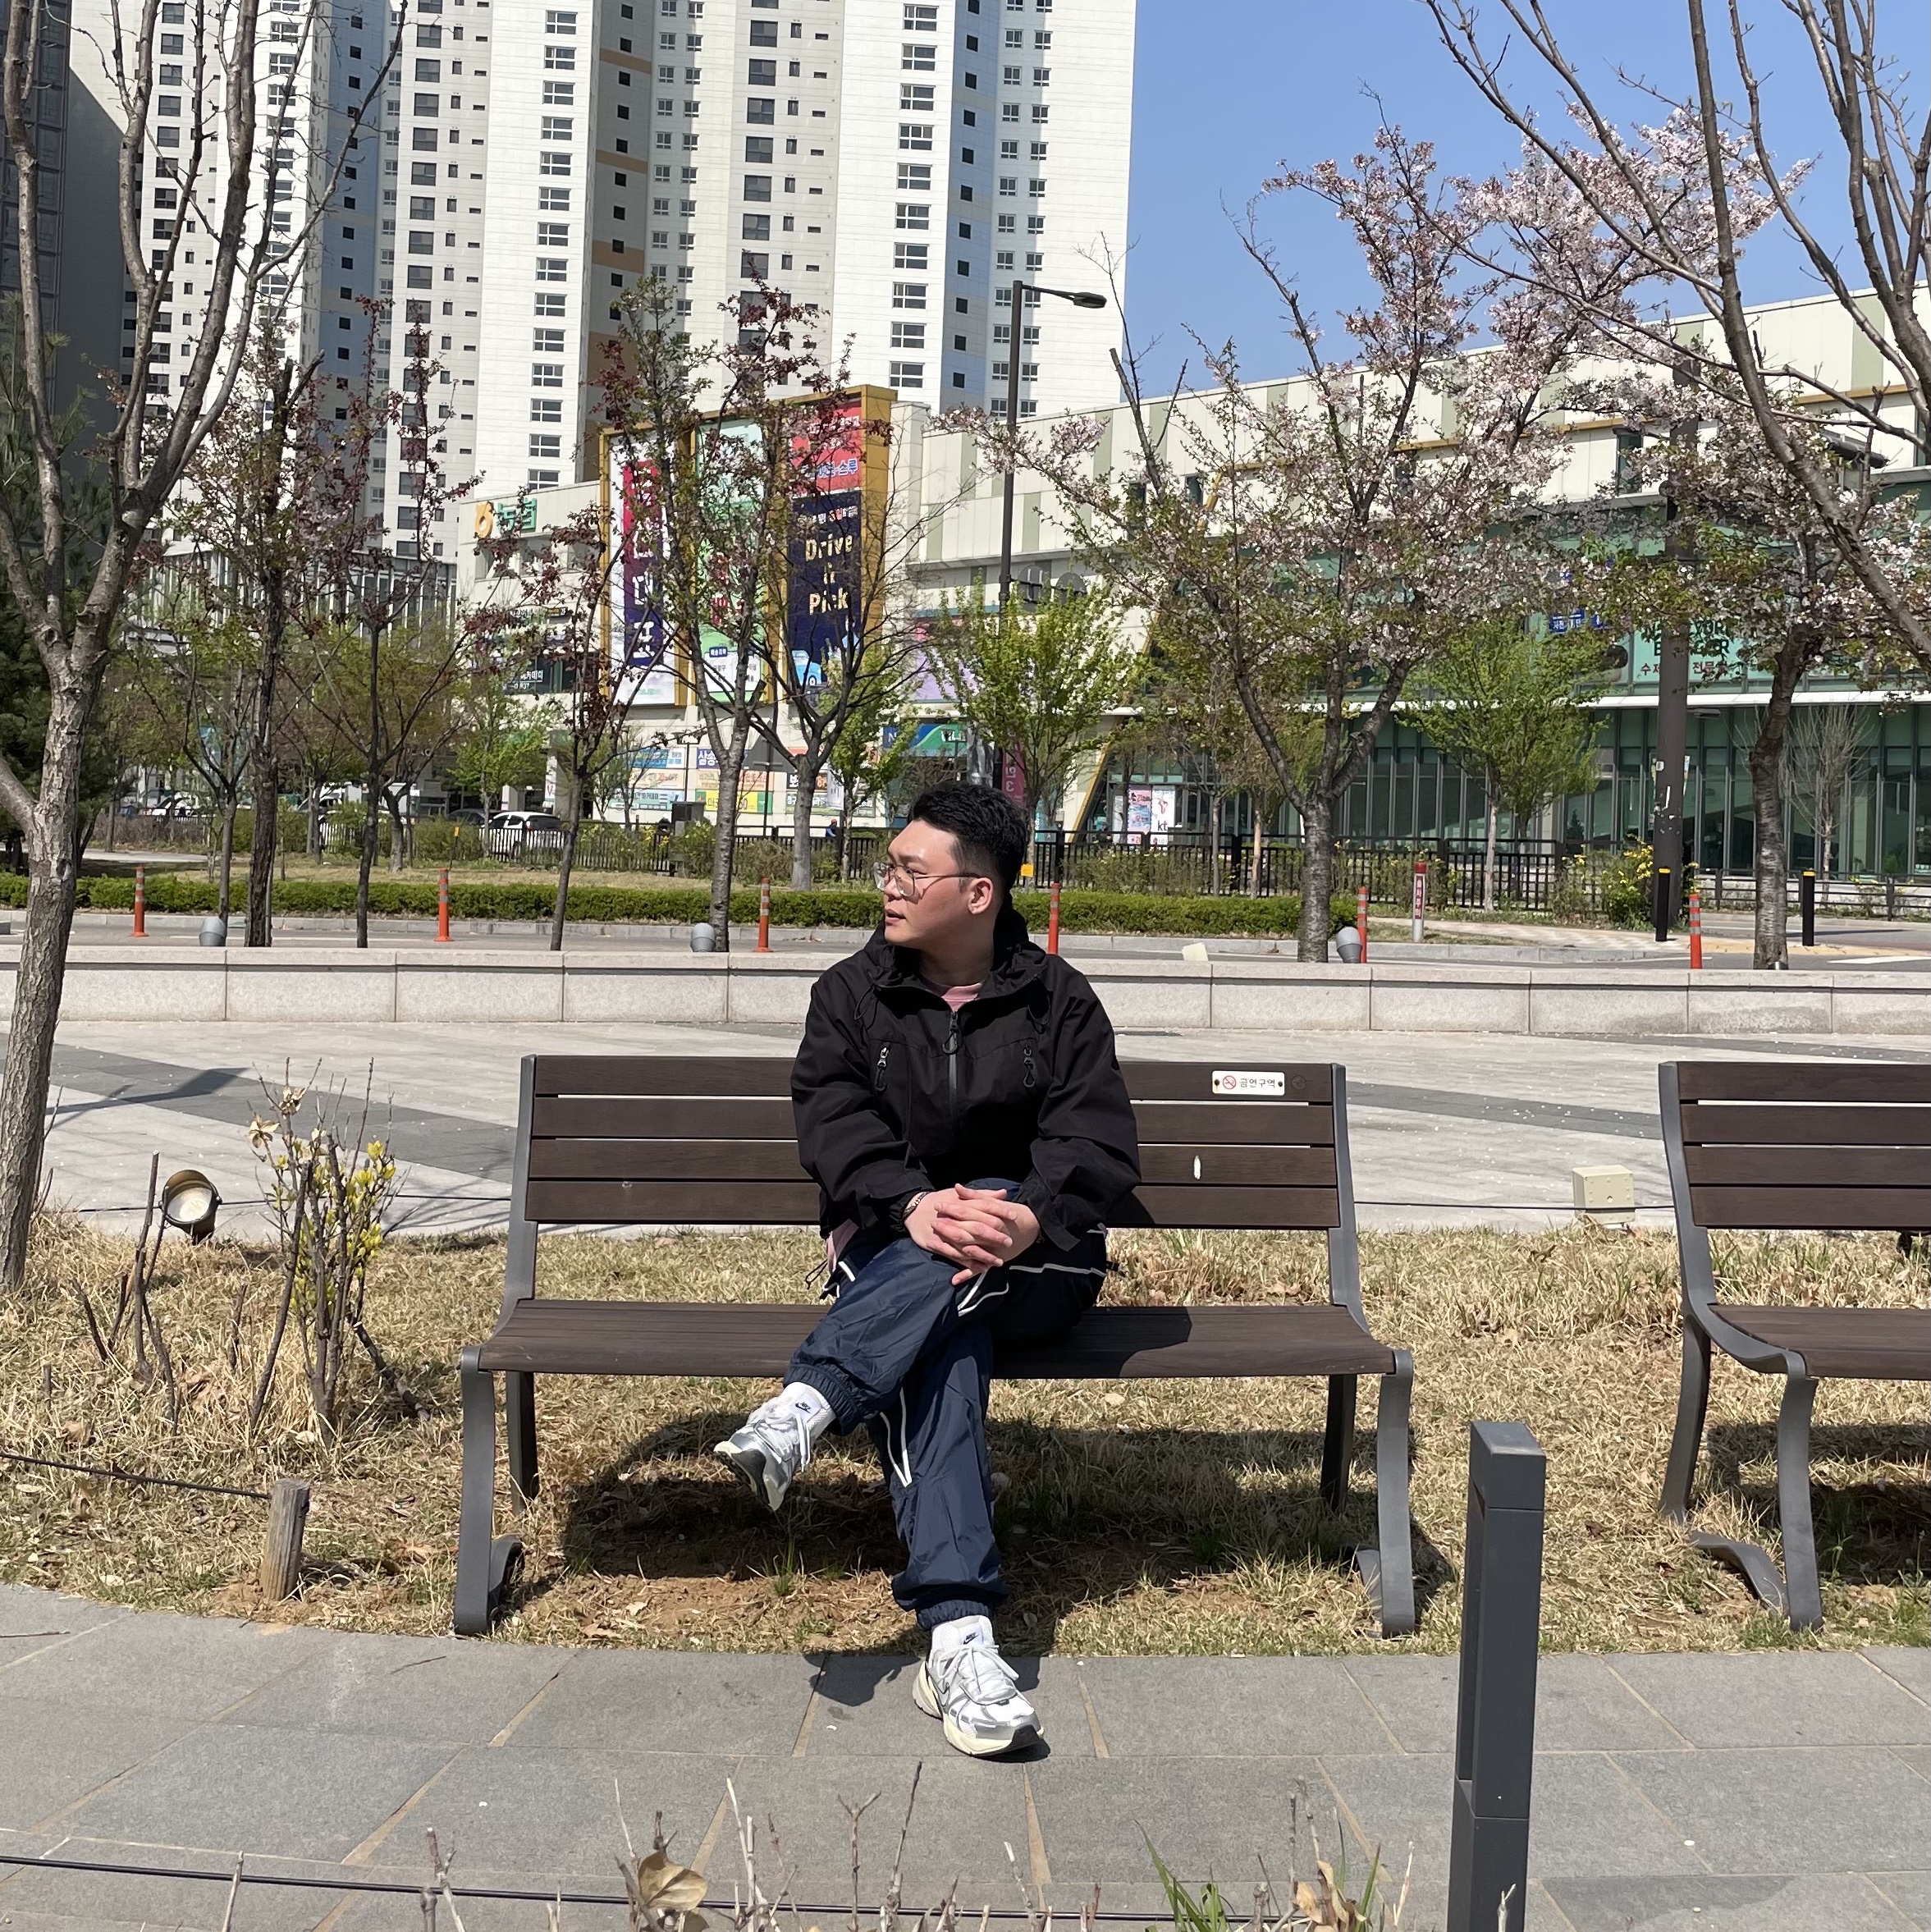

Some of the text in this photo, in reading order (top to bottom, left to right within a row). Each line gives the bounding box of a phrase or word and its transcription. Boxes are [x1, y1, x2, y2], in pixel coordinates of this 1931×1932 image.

[806, 533, 853, 562] Drive
[809, 588, 849, 616] Pick
[1157, 820, 1168, 831] kt
[1239, 1078, 1275, 1089] 금연구역
